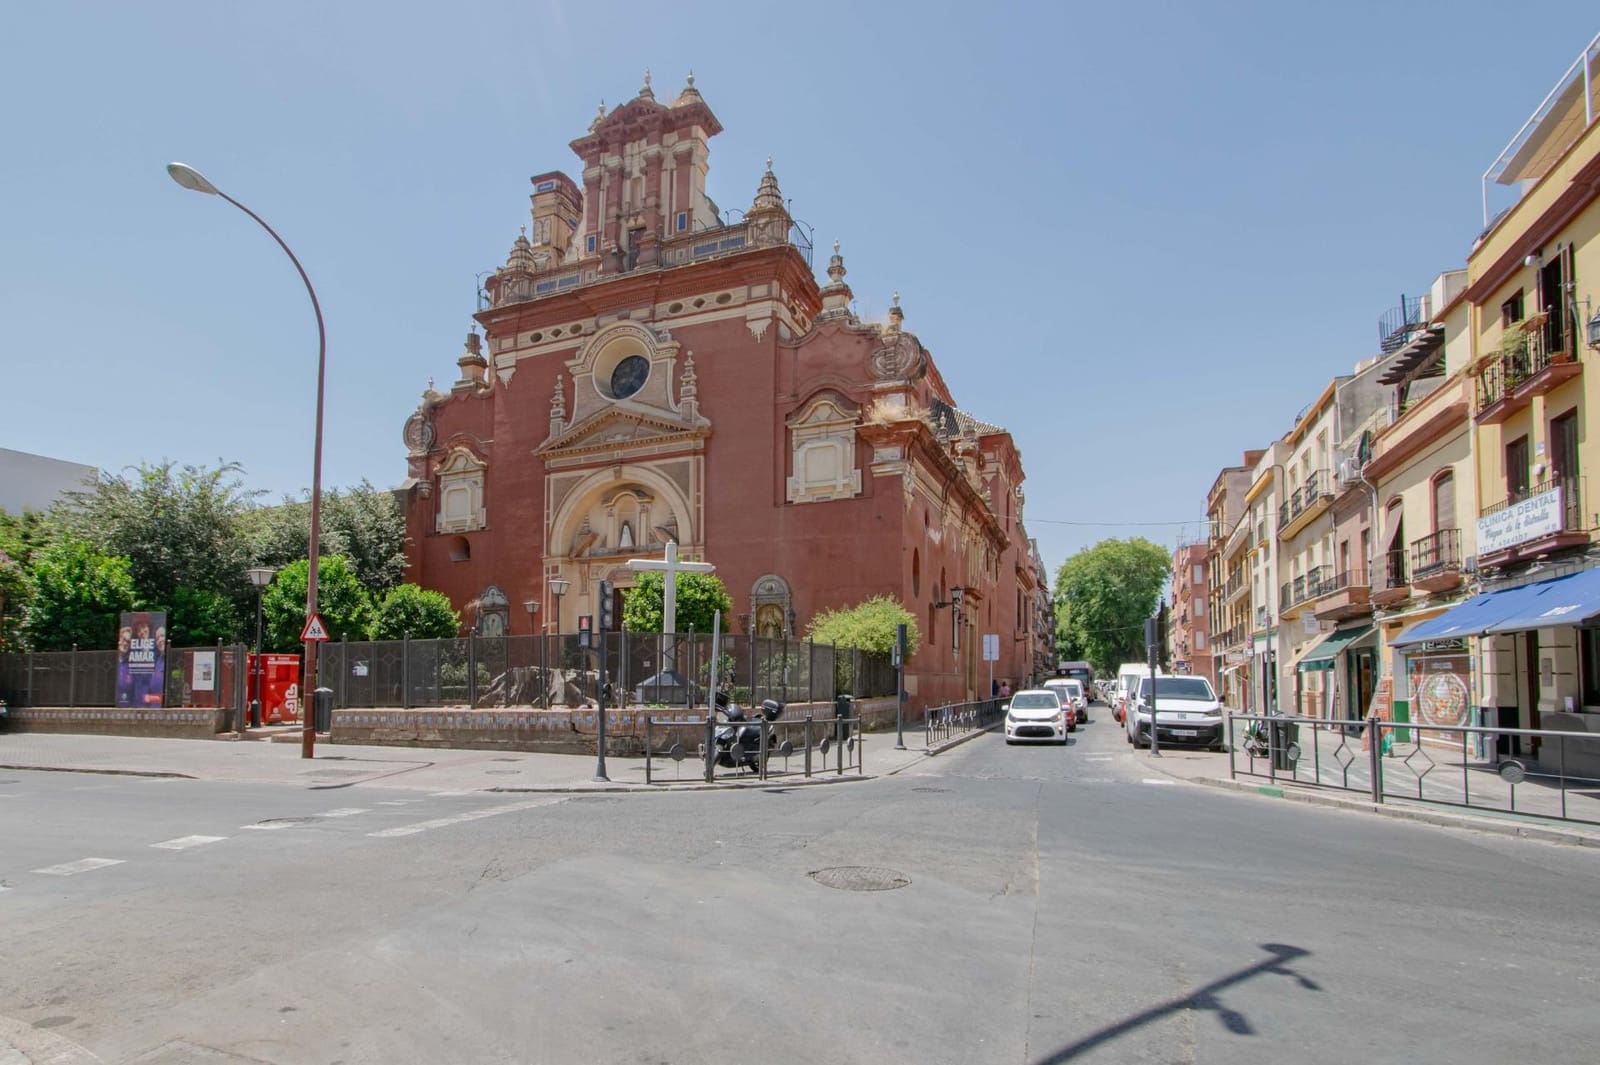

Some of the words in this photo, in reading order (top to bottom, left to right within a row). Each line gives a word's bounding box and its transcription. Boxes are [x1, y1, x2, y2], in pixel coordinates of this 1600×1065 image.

[1478, 511, 1514, 530] CLINICA
[1517, 493, 1557, 516] DENTAL
[130, 639, 155, 649] ELIGE
[128, 652, 155, 662] AMAR
